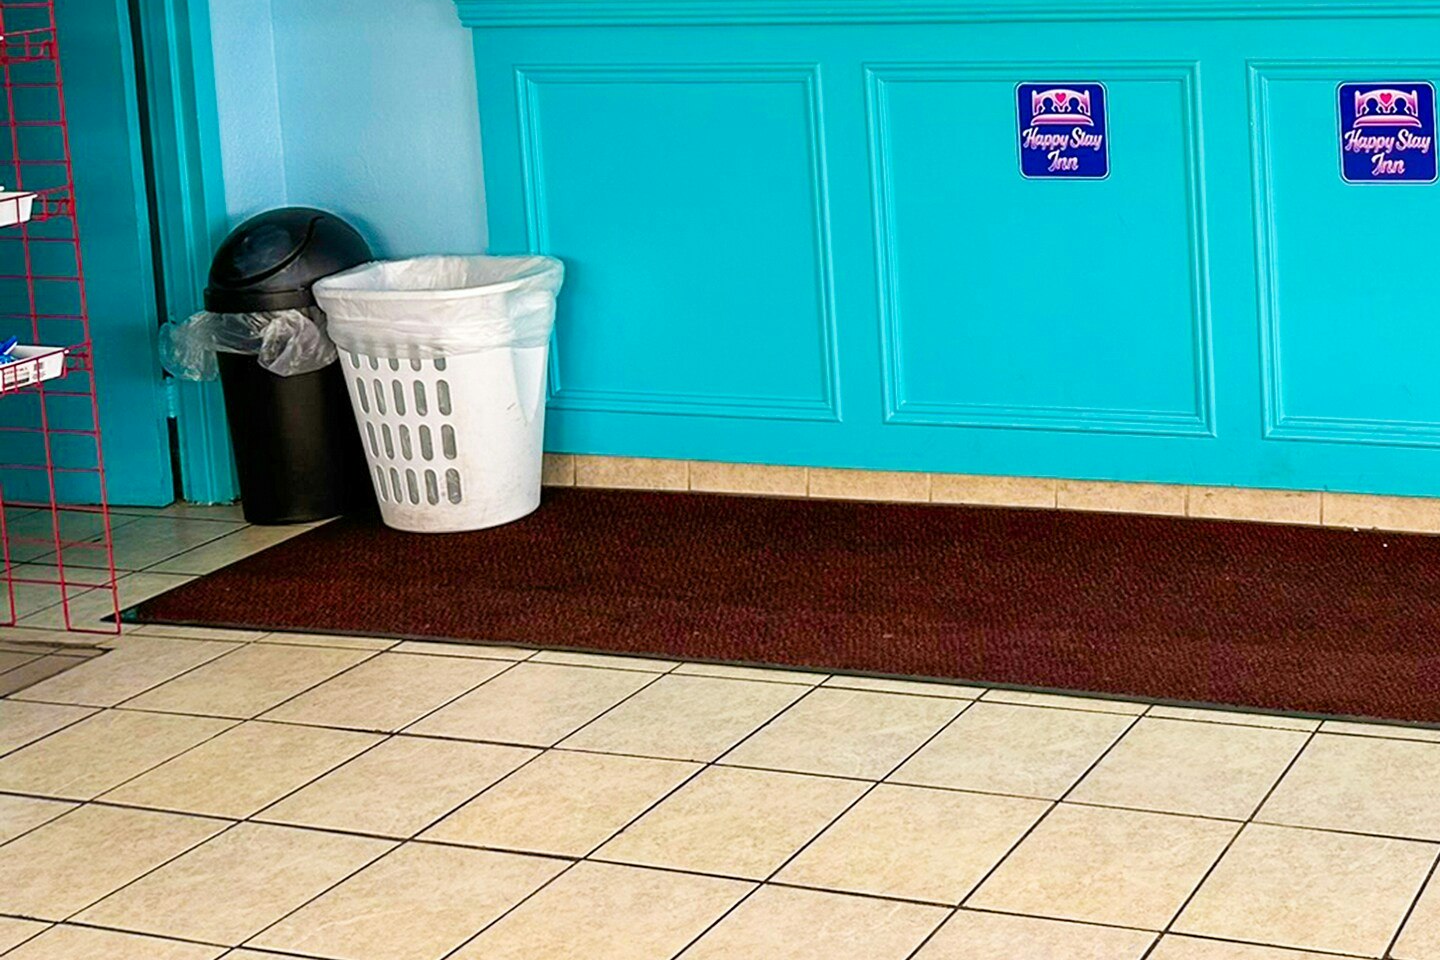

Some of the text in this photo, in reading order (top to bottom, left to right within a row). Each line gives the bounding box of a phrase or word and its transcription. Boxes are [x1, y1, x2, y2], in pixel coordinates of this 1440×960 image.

[1022, 127, 1102, 151] Happy Stay
[1344, 129, 1431, 153] Happy Stay
[1047, 150, 1079, 172] Inn
[1371, 152, 1405, 176] Inn
